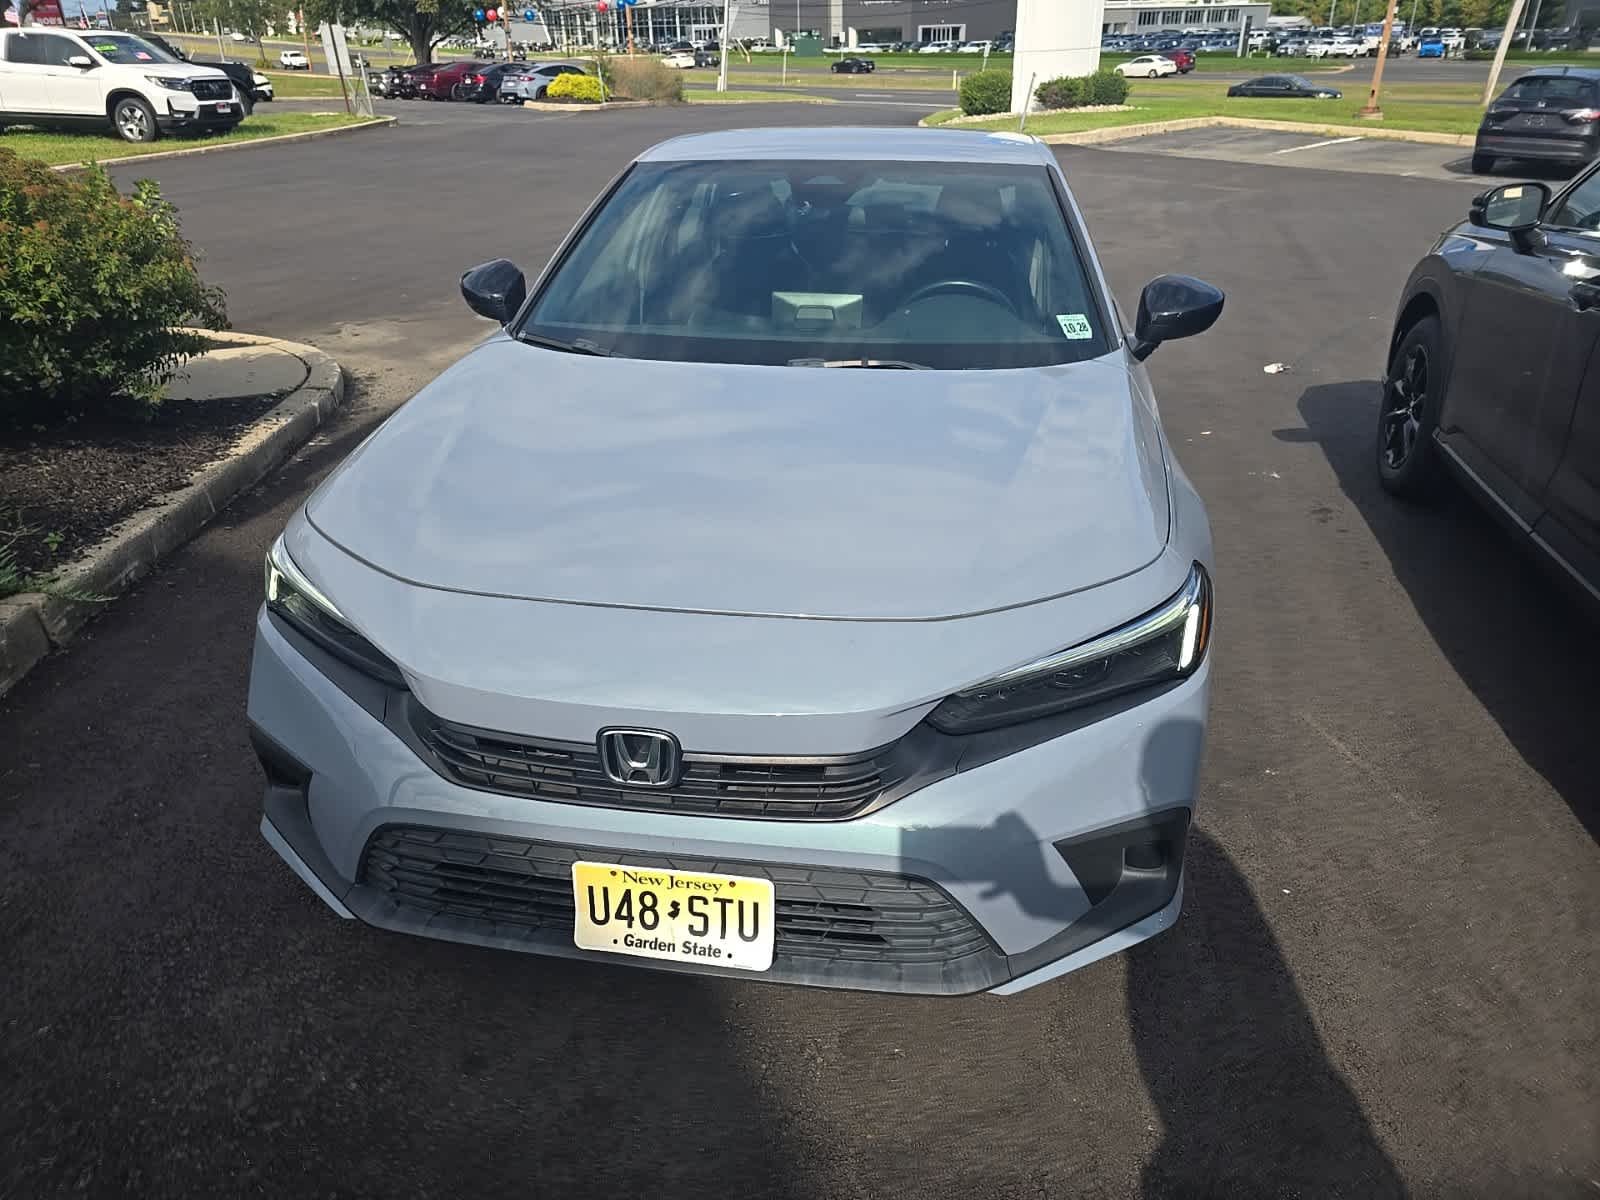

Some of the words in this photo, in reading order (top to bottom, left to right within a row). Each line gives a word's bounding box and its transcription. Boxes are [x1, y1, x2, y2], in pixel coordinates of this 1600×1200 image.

[1063, 322, 1076, 334] 10
[622, 870, 664, 887] New
[667, 875, 723, 894] Jersey
[587, 885, 660, 931] U48
[687, 894, 759, 942] STU
[623, 933, 676, 953] Garden
[681, 940, 722, 959] State
